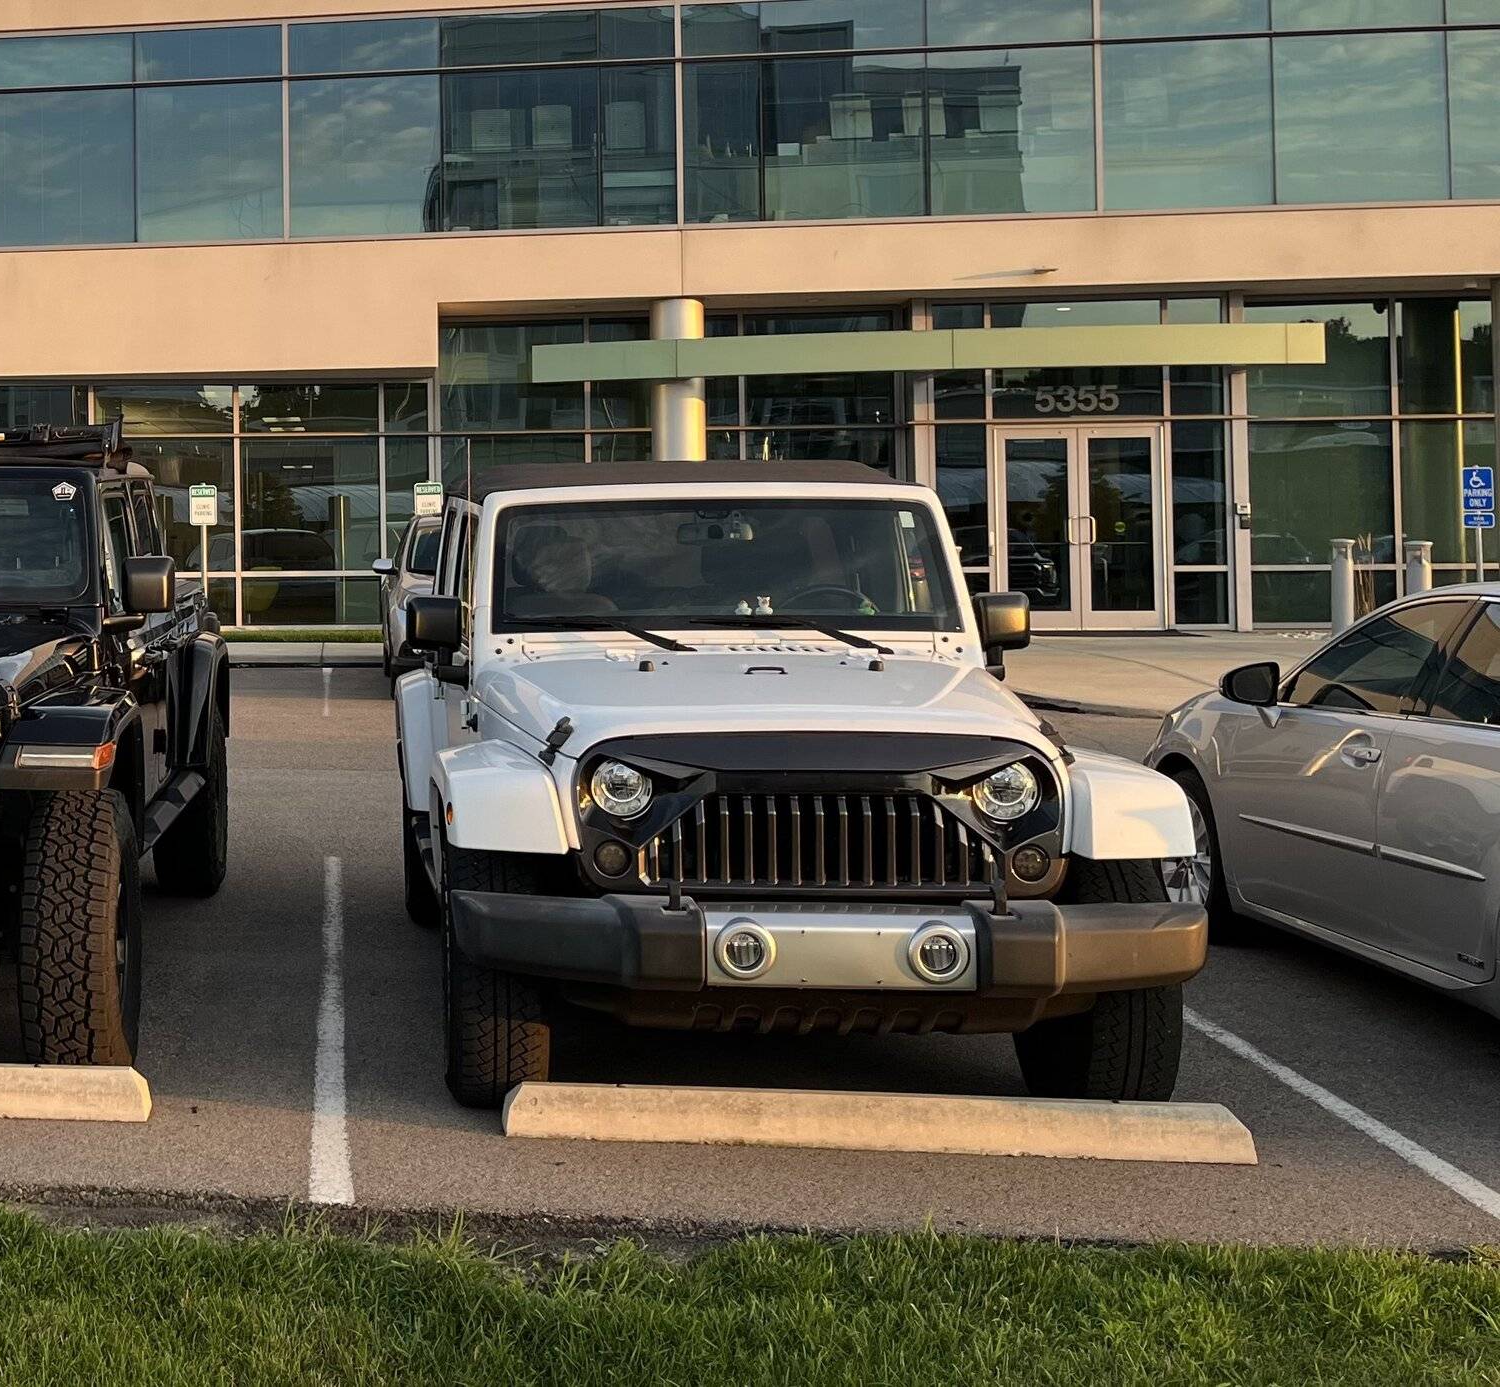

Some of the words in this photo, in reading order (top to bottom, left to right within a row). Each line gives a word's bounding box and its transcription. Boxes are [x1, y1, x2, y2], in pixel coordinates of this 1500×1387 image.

[1035, 385, 1120, 413] 5355
[1463, 488, 1493, 497] PARKING
[1469, 498, 1487, 507] ONLY
